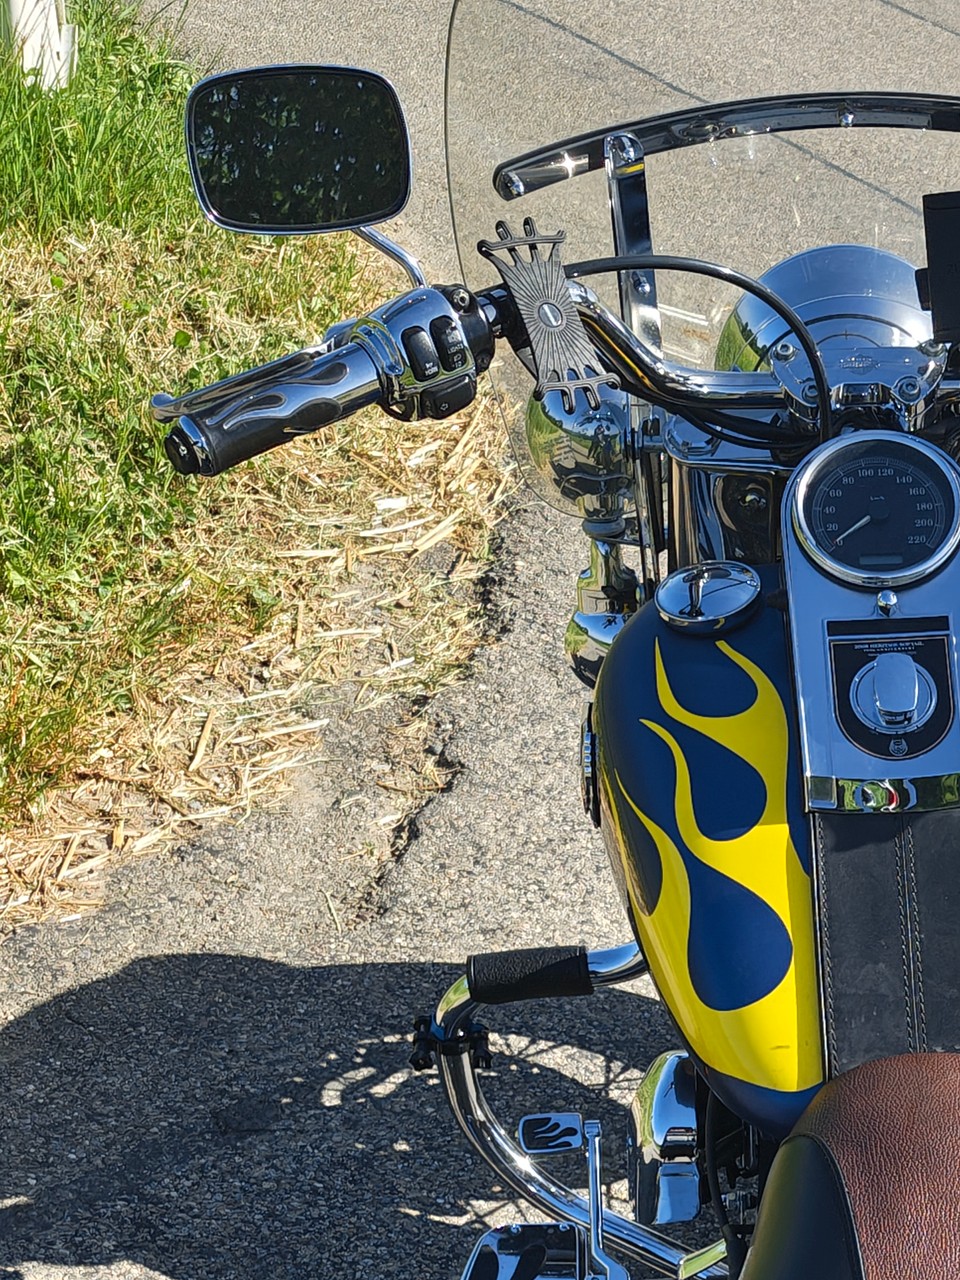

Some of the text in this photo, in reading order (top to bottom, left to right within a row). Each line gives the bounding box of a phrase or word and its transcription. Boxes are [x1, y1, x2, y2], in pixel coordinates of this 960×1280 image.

[858, 469, 874, 477] 100
[878, 468, 894, 476] 120
[842, 476, 854, 485] 80
[896, 475, 913, 484] 140
[829, 489, 842, 497] 60
[909, 487, 926, 496] 160
[823, 506, 836, 514] 40
[916, 503, 933, 511] 180
[826, 523, 839, 531] 20
[915, 519, 933, 527] 200
[907, 535, 926, 544] 220
